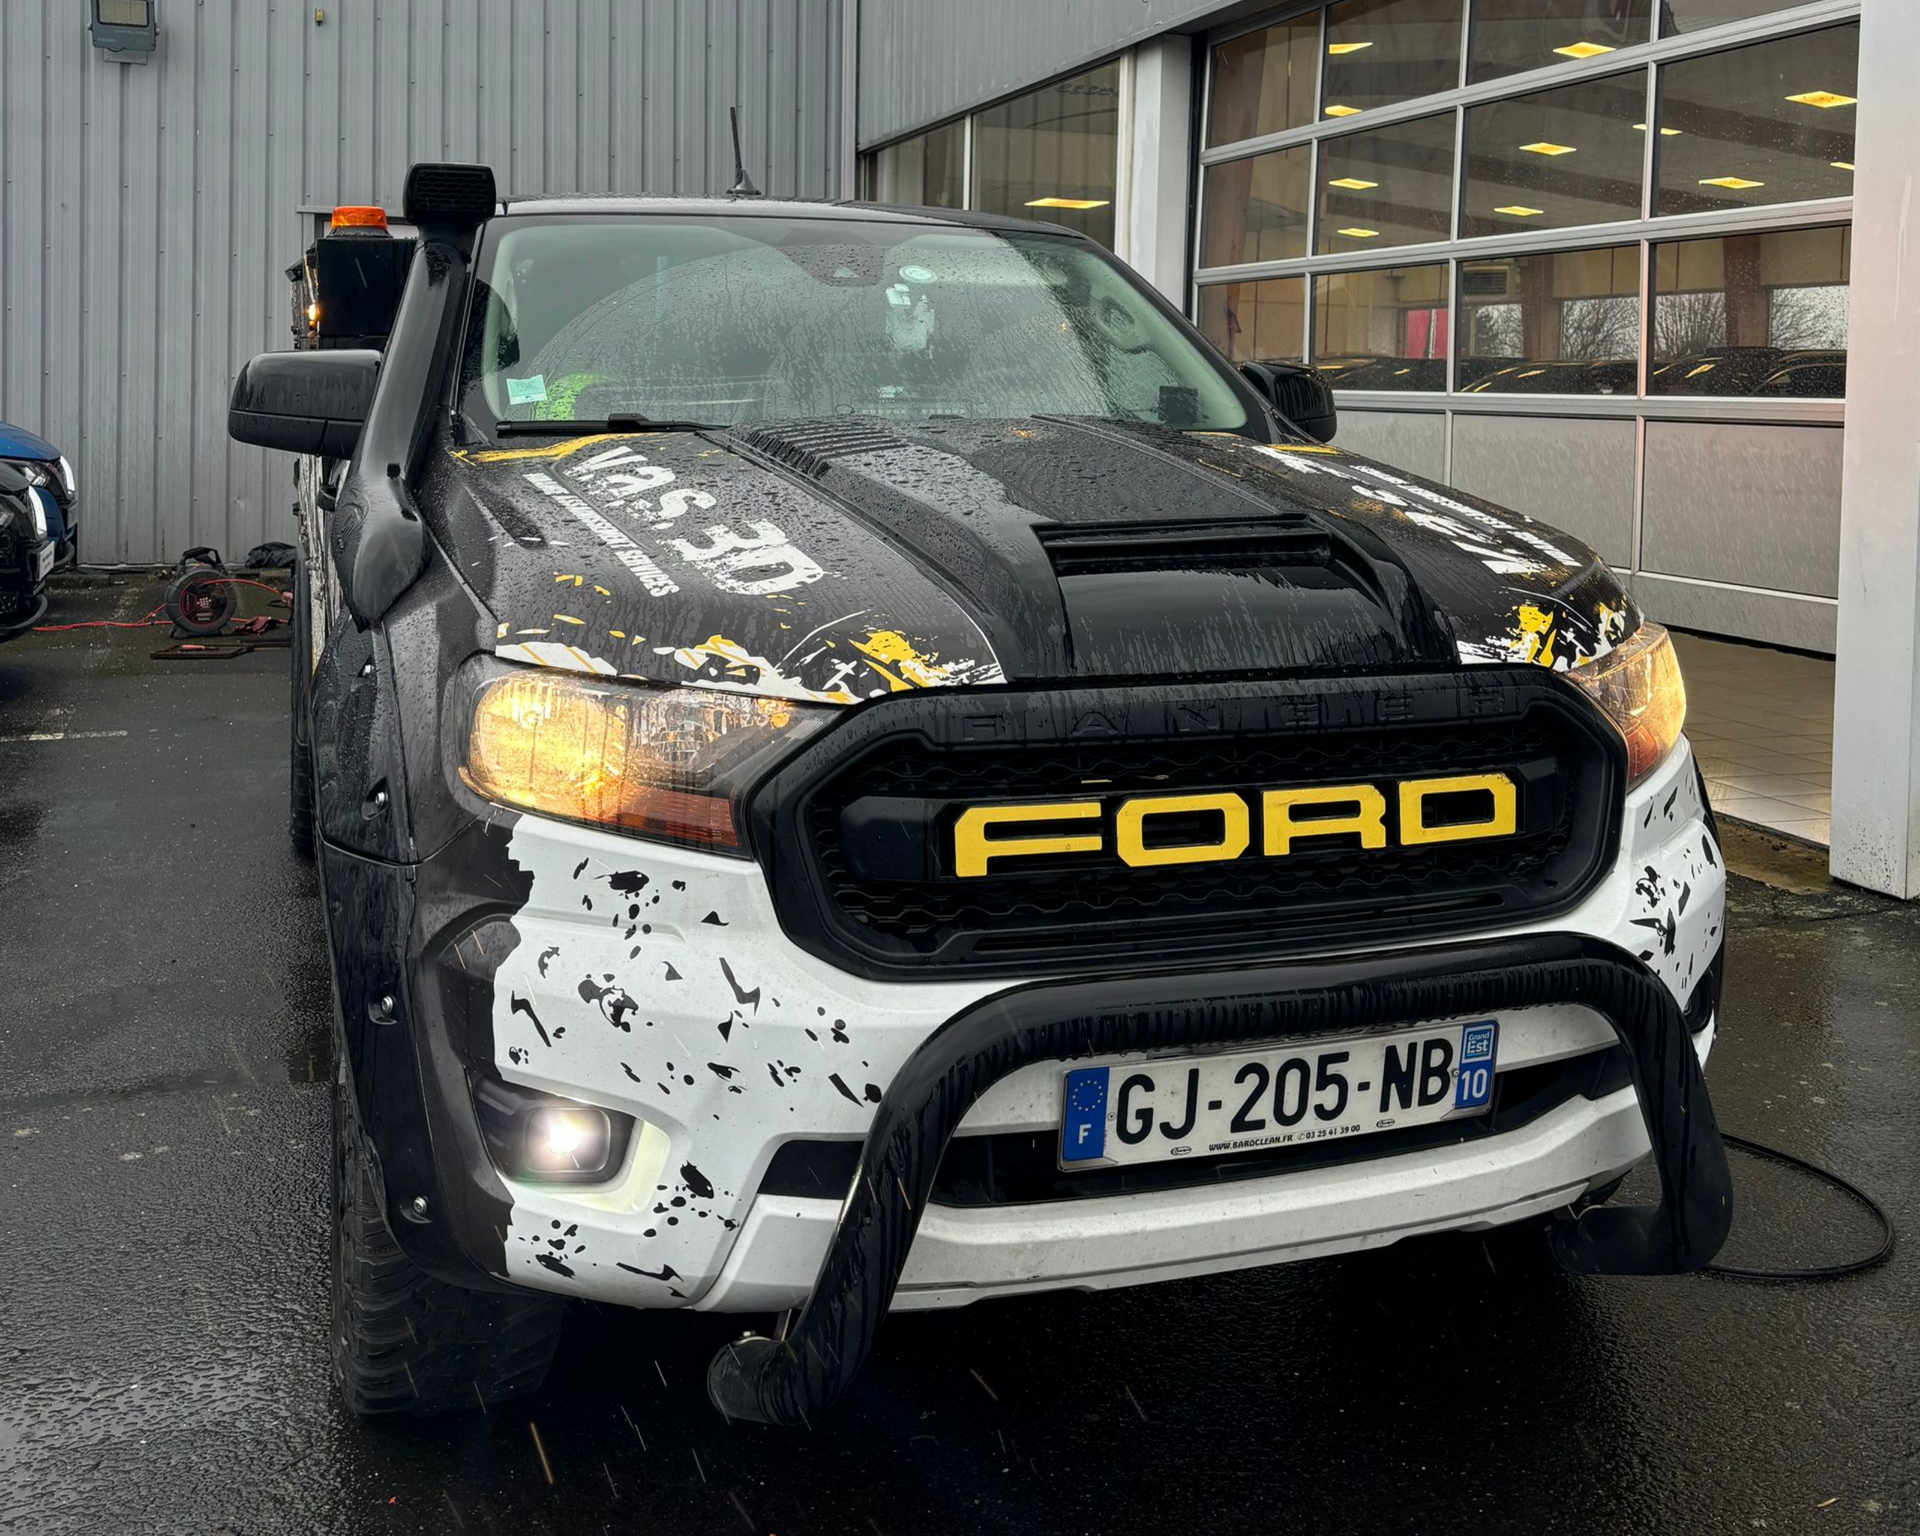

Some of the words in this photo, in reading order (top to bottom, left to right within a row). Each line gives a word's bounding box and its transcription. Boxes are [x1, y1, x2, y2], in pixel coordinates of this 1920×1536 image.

[614, 550, 679, 597] SERVICES
[954, 772, 1517, 878] FORD
[1467, 1039, 1488, 1054] Est
[1468, 1032, 1490, 1041] Grand
[1116, 1038, 1454, 1145] GJ-205-NB
[1461, 1068, 1488, 1100] 10
[1077, 1124, 1089, 1145] F
[1317, 1130, 1327, 1138] 25
[1340, 1127, 1349, 1135] 39
[1350, 1125, 1361, 1133] 00
